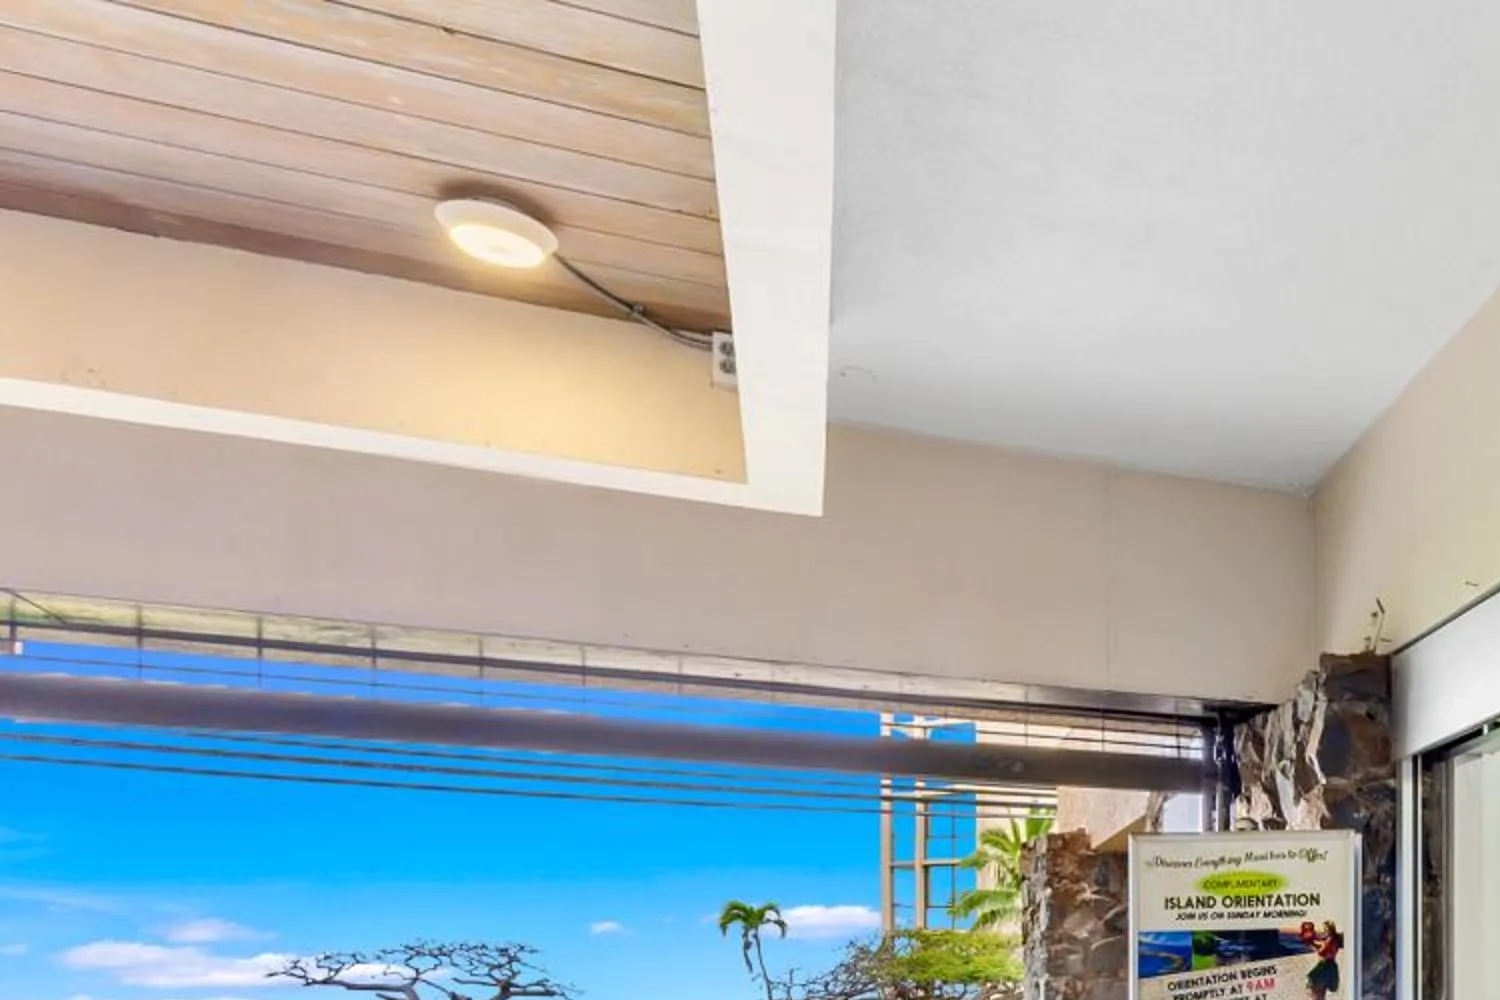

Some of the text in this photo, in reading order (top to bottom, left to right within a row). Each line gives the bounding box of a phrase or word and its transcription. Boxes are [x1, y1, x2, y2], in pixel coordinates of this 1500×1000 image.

[1203, 878, 1278, 890] COMPLIMENTARY
[1164, 892, 1321, 910] ISLAND ORIENTATION
[1175, 909, 1308, 921] JOIN US ON SUNDAY MORNING!
[1168, 964, 1277, 991] ORIENTATION BEGINS
[1229, 985, 1244, 997] AT
[1245, 977, 1276, 993] 9AM
